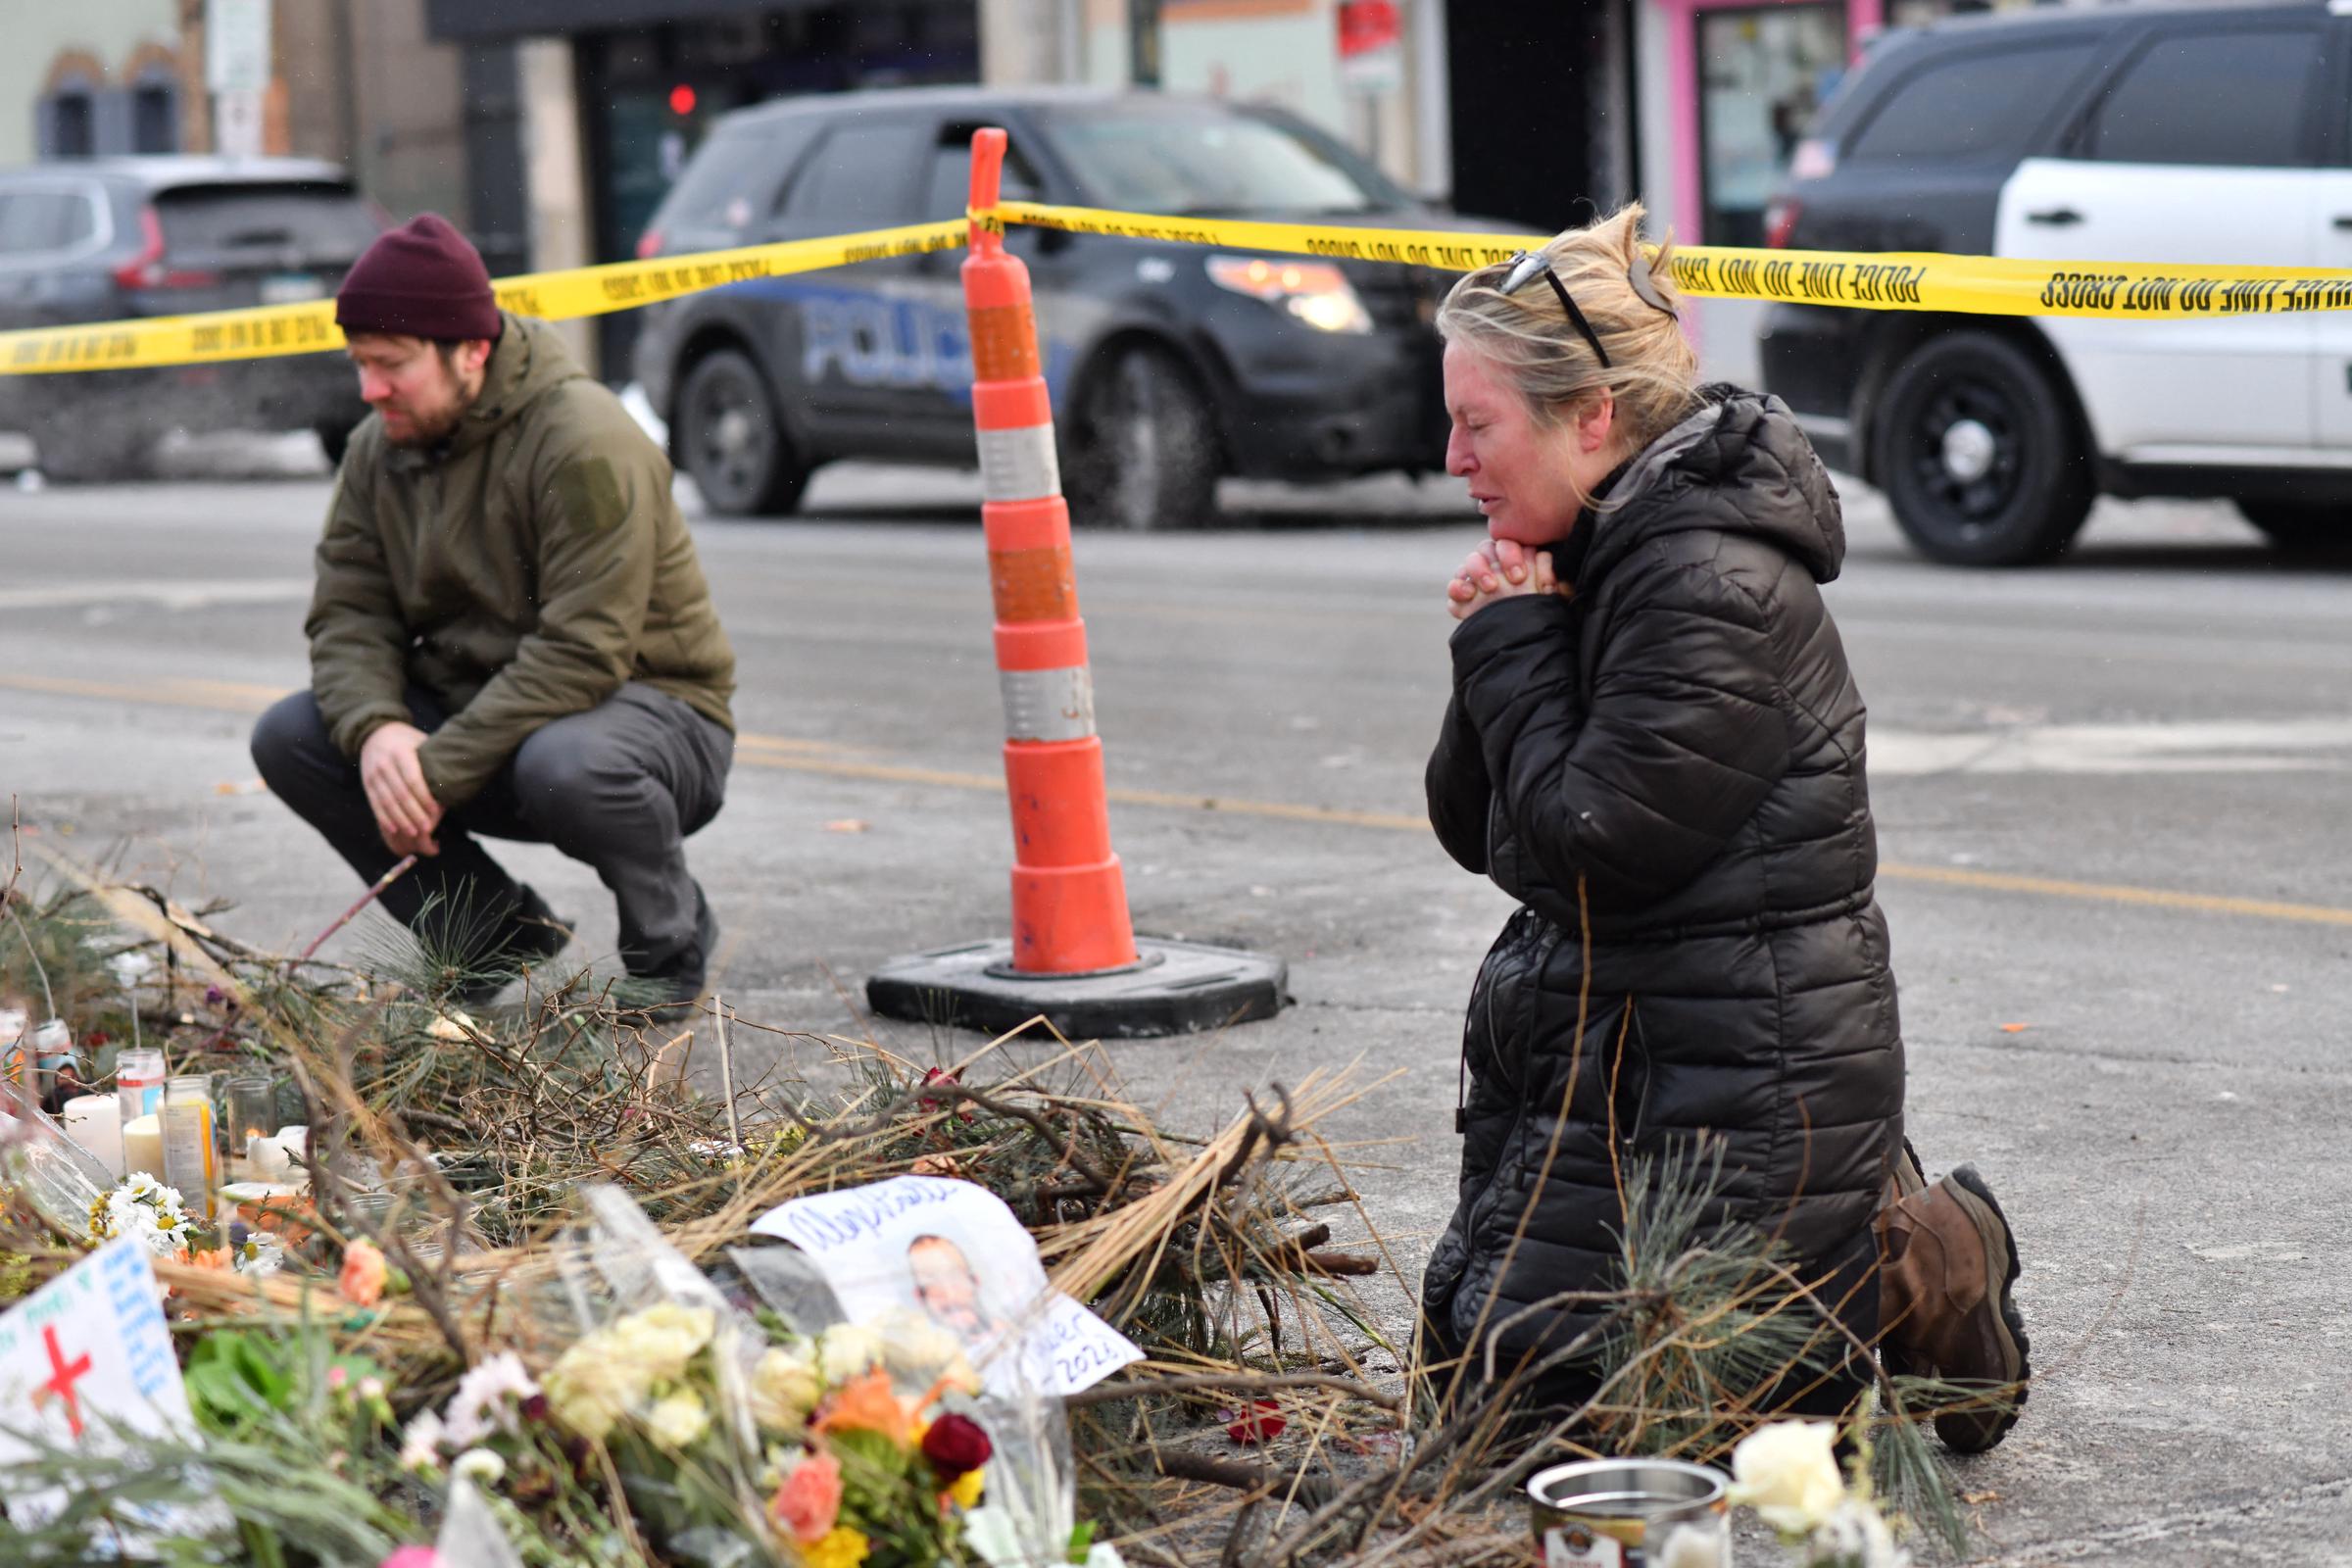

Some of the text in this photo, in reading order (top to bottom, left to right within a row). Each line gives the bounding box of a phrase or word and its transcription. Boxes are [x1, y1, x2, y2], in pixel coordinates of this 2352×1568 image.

[1670, 256, 1927, 303] POLICE LINE DO NOT CRO
[2039, 271, 2129, 311] CROSS
[2122, 276, 2186, 311] NOT
[2179, 277, 2220, 312] DO
[2219, 278, 2288, 313] LINE
